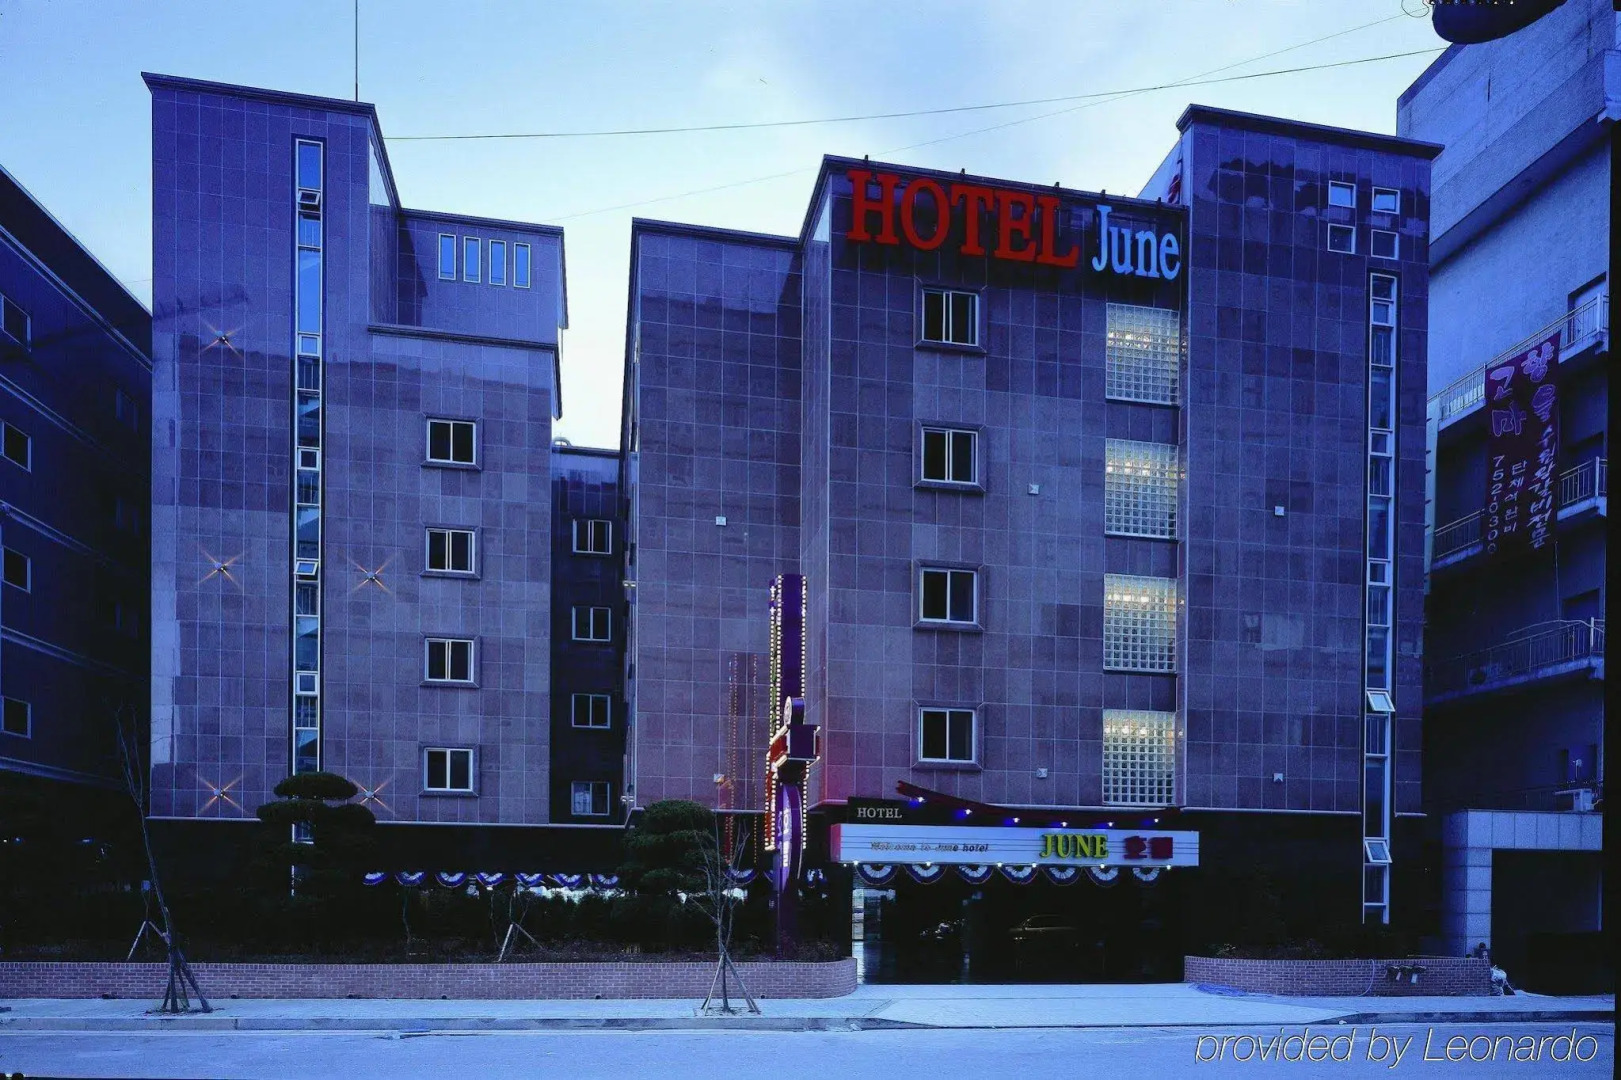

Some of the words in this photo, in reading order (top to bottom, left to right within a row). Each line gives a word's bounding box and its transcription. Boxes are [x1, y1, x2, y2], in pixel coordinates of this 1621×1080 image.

[846, 168, 1079, 268] HOTEL
[1092, 205, 1181, 281] June
[857, 807, 902, 818] HOTEL
[962, 843, 989, 853] hotel
[1040, 833, 1109, 858] JUNE
